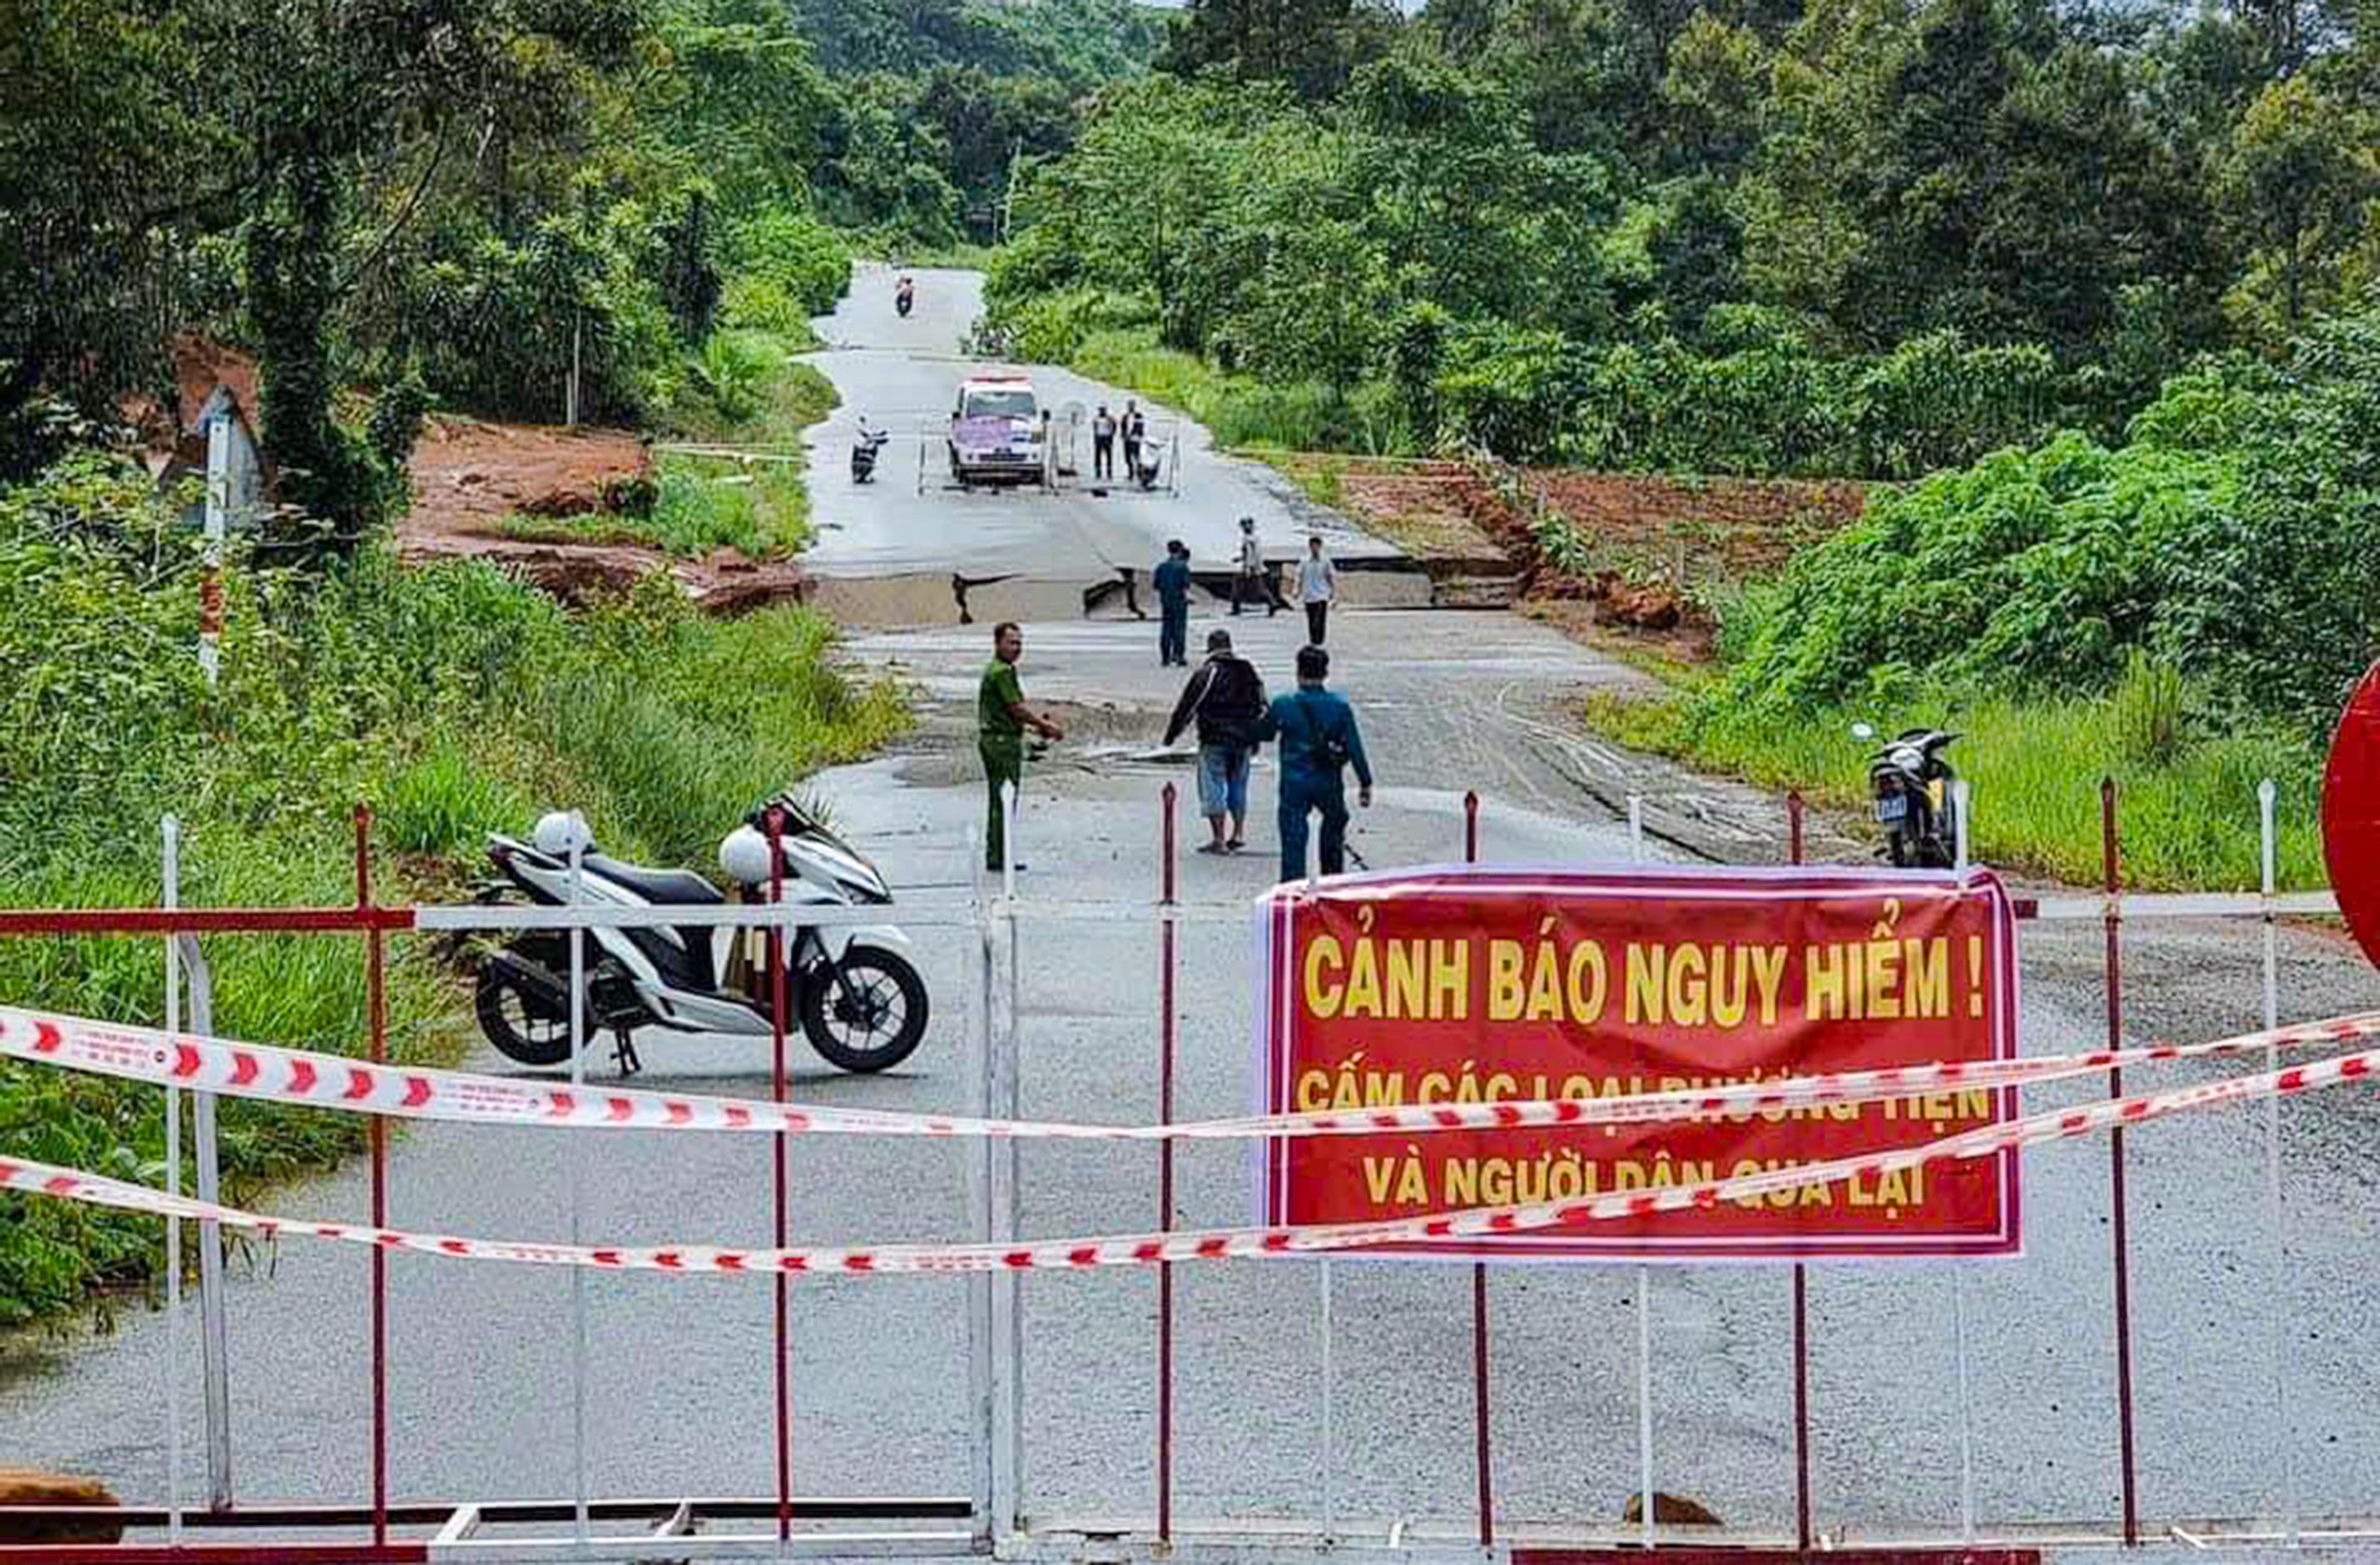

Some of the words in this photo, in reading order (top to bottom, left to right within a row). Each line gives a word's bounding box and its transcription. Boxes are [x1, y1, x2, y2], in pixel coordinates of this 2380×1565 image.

[1303, 905, 1469, 1020] CẢNH
[1488, 916, 1607, 1024] BÁO
[1625, 942, 1788, 1028] NGUY
[1805, 898, 1950, 1021] HIỂM
[1968, 935, 1983, 1018] !
[1297, 1052, 1405, 1112] CẤM
[1418, 1060, 1517, 1105] CÁC
[1363, 1145, 1429, 1205] VÀ
[1444, 1147, 1598, 1207] NGƯỜI
[1731, 1159, 1832, 1209] QUA
[1848, 1165, 1924, 1219] LẠI
